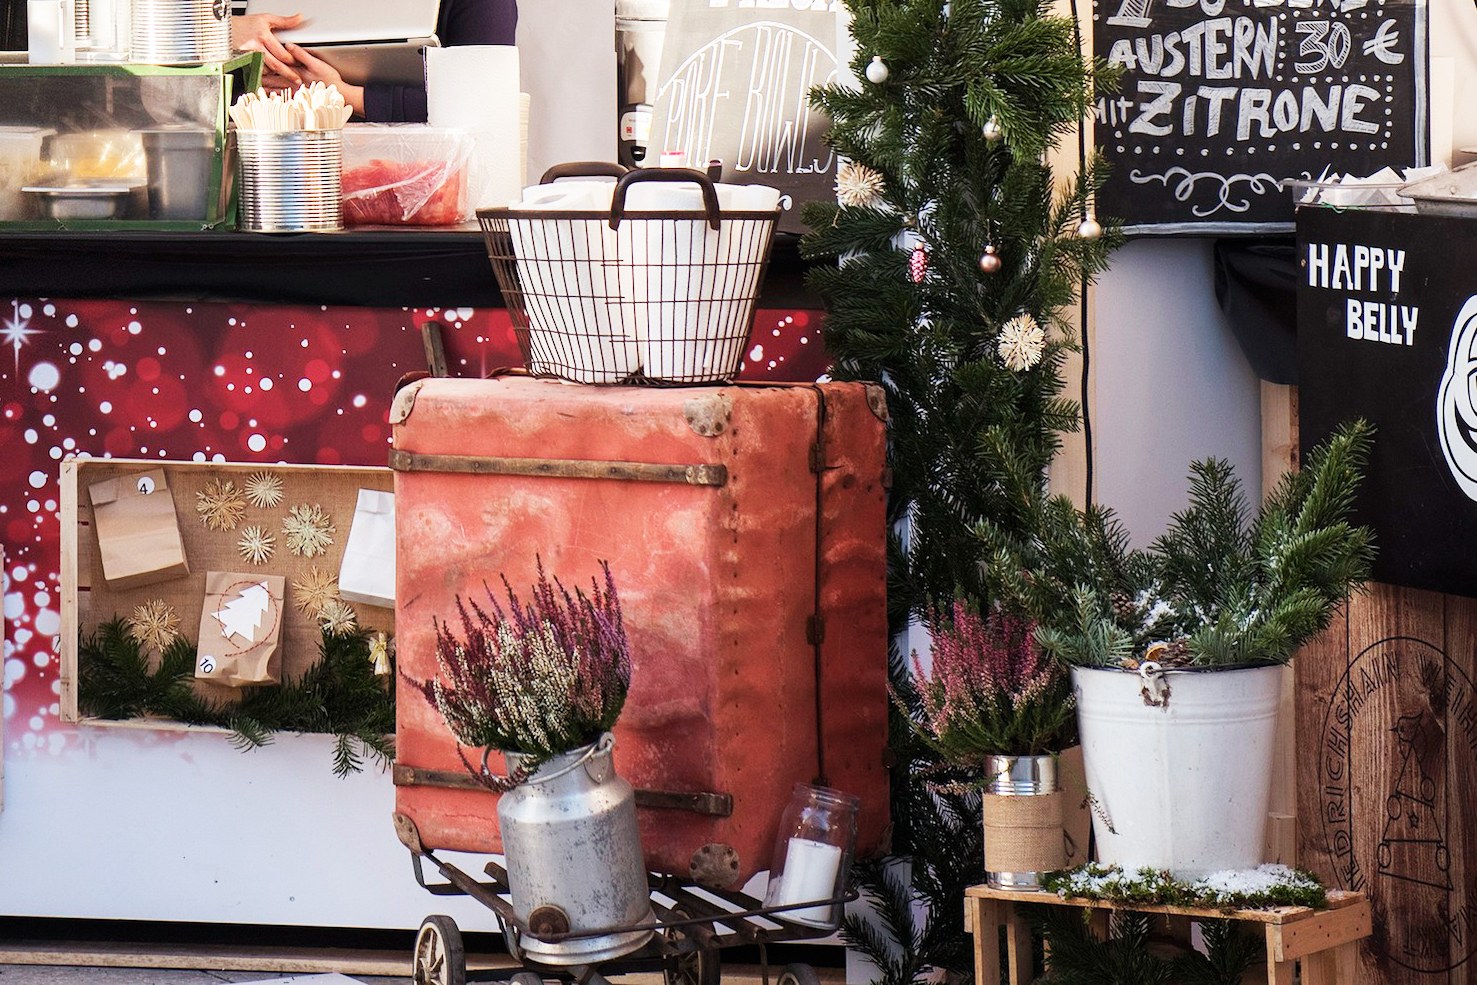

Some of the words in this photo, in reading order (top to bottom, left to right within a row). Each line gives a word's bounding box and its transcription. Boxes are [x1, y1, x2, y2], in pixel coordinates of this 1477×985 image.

[1109, 16, 1278, 80] AUSTERN
[1294, 21, 1352, 75] 30
[1363, 19, 1405, 65] €
[1128, 80, 1381, 140] ZITRONE
[1308, 243, 1405, 293] HAPPY
[1346, 298, 1419, 346] BELLY
[139, 483, 148, 495] 4
[199, 658, 214, 674] 10
